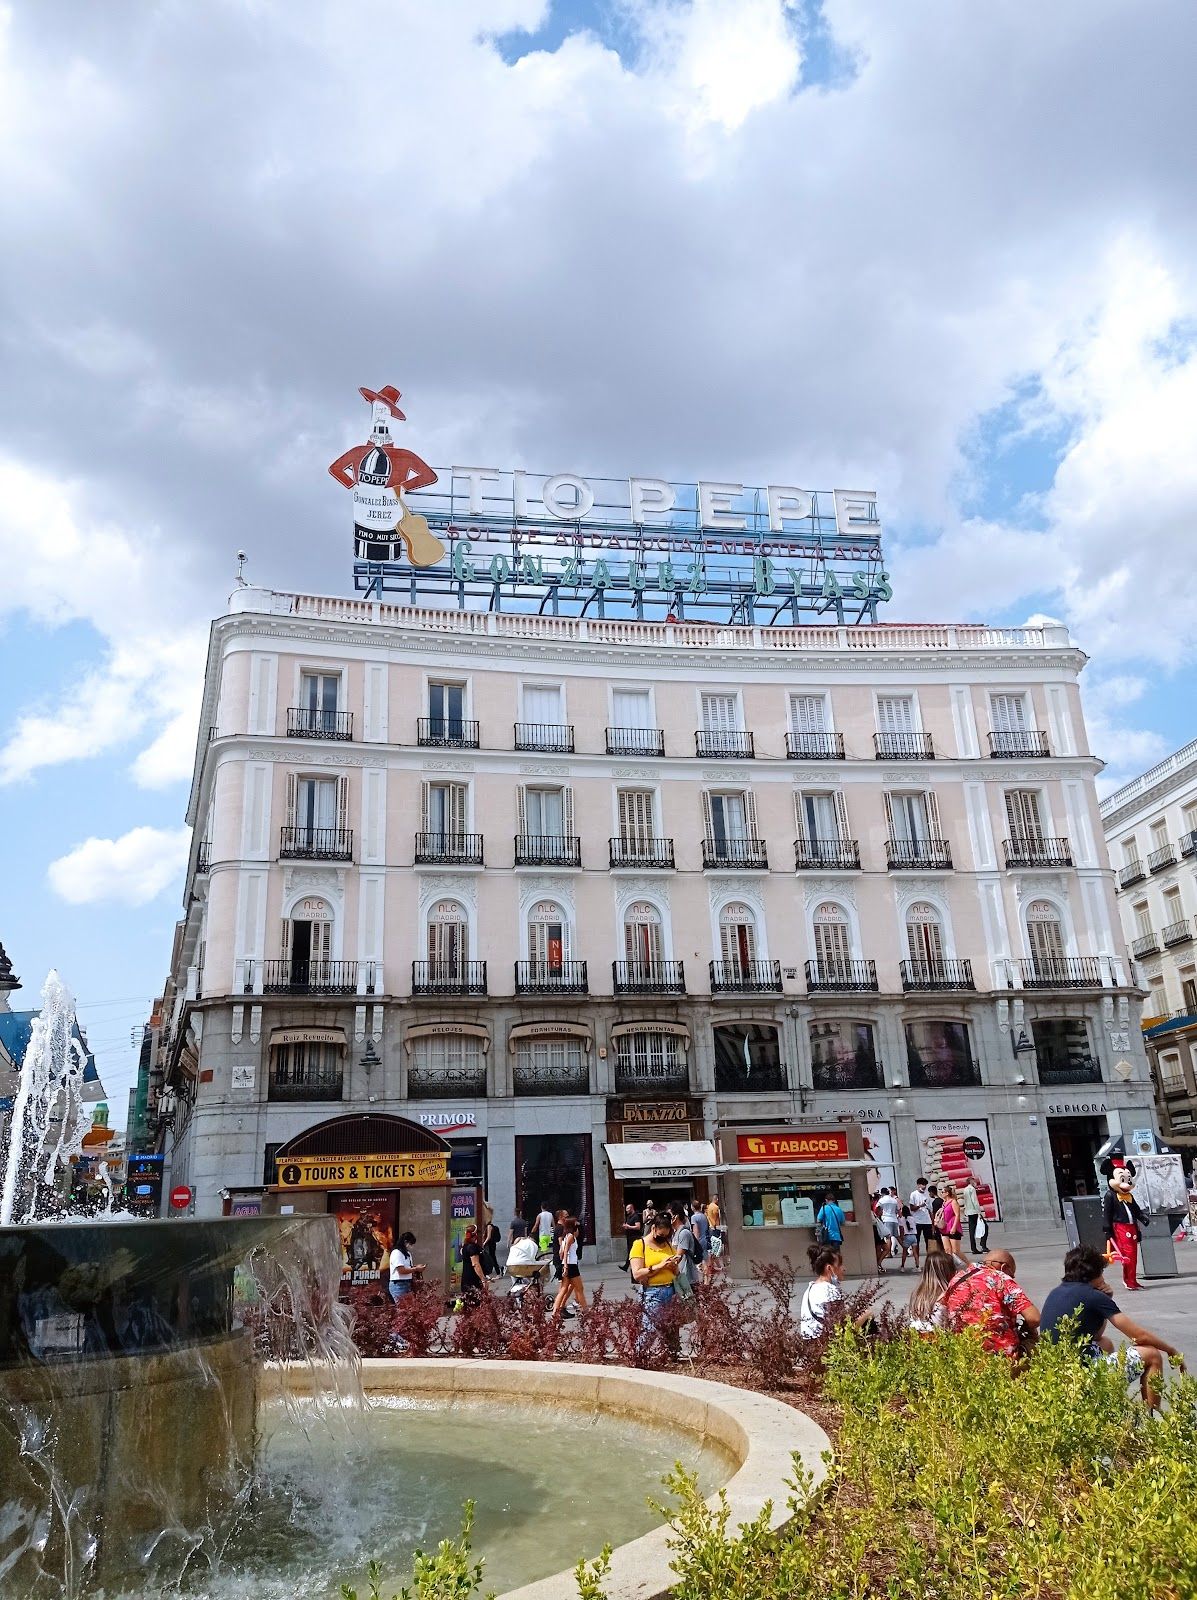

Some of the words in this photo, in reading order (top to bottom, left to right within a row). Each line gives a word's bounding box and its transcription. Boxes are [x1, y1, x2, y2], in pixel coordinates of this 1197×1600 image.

[452, 466, 595, 520] TIO
[629, 477, 881, 537] PEPE
[366, 510, 392, 519] JEREZ
[358, 530, 374, 539] FINO
[447, 525, 499, 542] SOL
[510, 528, 541, 543] DE
[454, 541, 707, 593] GONZALEZ
[753, 556, 893, 601] BYASS
[626, 1108, 686, 1121] PALAZZO
[1048, 1103, 1107, 1113] SEPHORA
[419, 1112, 476, 1126] PRIMOR
[947, 1123, 970, 1131] Beauty
[771, 1139, 839, 1153] TABACOS
[304, 1166, 345, 1181] TOURS
[349, 1166, 358, 1179] &
[364, 1164, 415, 1179] TICKETS
[418, 1163, 445, 1176] OFFICIAL
[652, 1168, 688, 1177] PALAZZO
[453, 1207, 471, 1217] FRIA
[353, 1270, 381, 1280] PURGA
